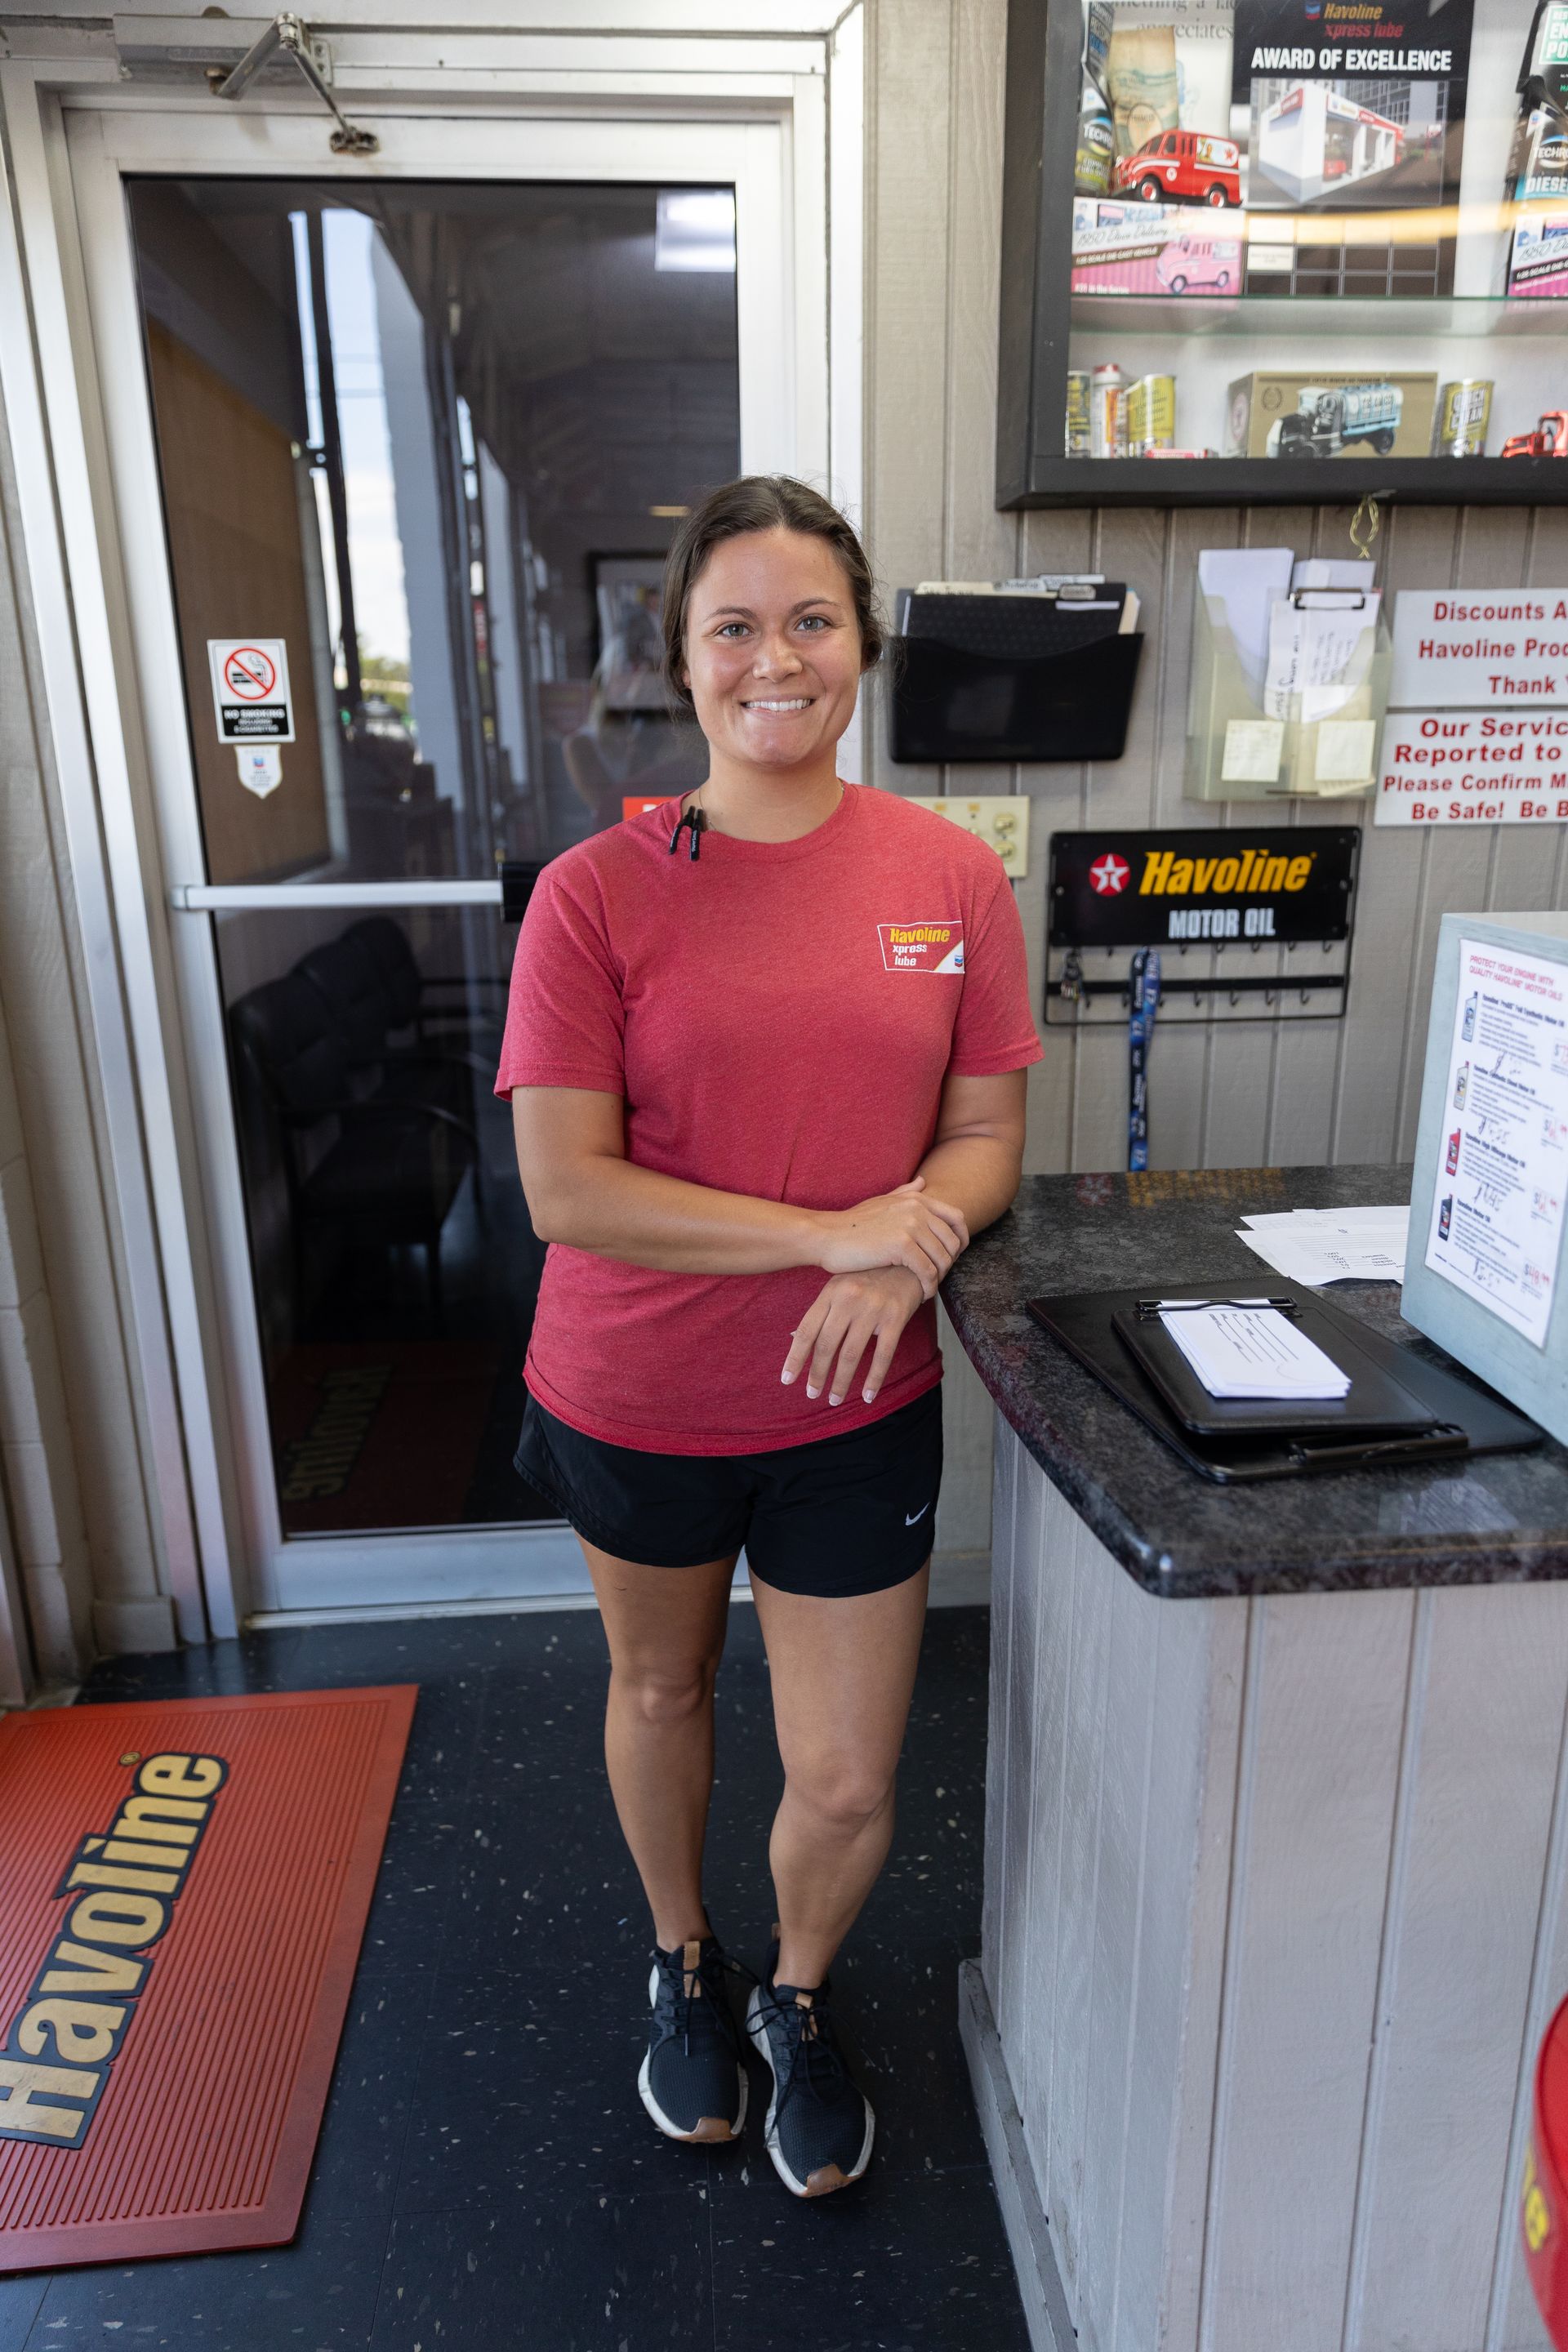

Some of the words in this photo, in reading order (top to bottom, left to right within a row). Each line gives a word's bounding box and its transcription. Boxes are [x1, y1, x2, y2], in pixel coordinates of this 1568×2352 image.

[1323, 2, 1383, 20] Havoline
[1251, 47, 1316, 69] AWARD
[1319, 48, 1343, 69] OF
[1345, 49, 1452, 71] EXCELLENCE
[1526, 176, 1568, 194] DIESE
[1433, 601, 1544, 621] Discounts
[1419, 639, 1516, 658] Havoline
[1488, 675, 1557, 695] Thank
[1420, 718, 1470, 737] Our
[1394, 743, 1524, 767] Reported
[1536, 743, 1561, 761] to
[1383, 775, 1453, 792] Please
[1461, 773, 1542, 791] Confirm
[1411, 802, 1439, 821] Be
[1449, 801, 1504, 820] Safe!
[1520, 800, 1548, 818] Be
[1138, 849, 1313, 896] Havoline
[1169, 908, 1241, 939] MOTOR
[1244, 907, 1276, 937] OIL
[889, 926, 951, 943] Havoline
[893, 944, 928, 956] xpress
[894, 955, 917, 966] lube
[0, 1753, 225, 2143] Havoline
